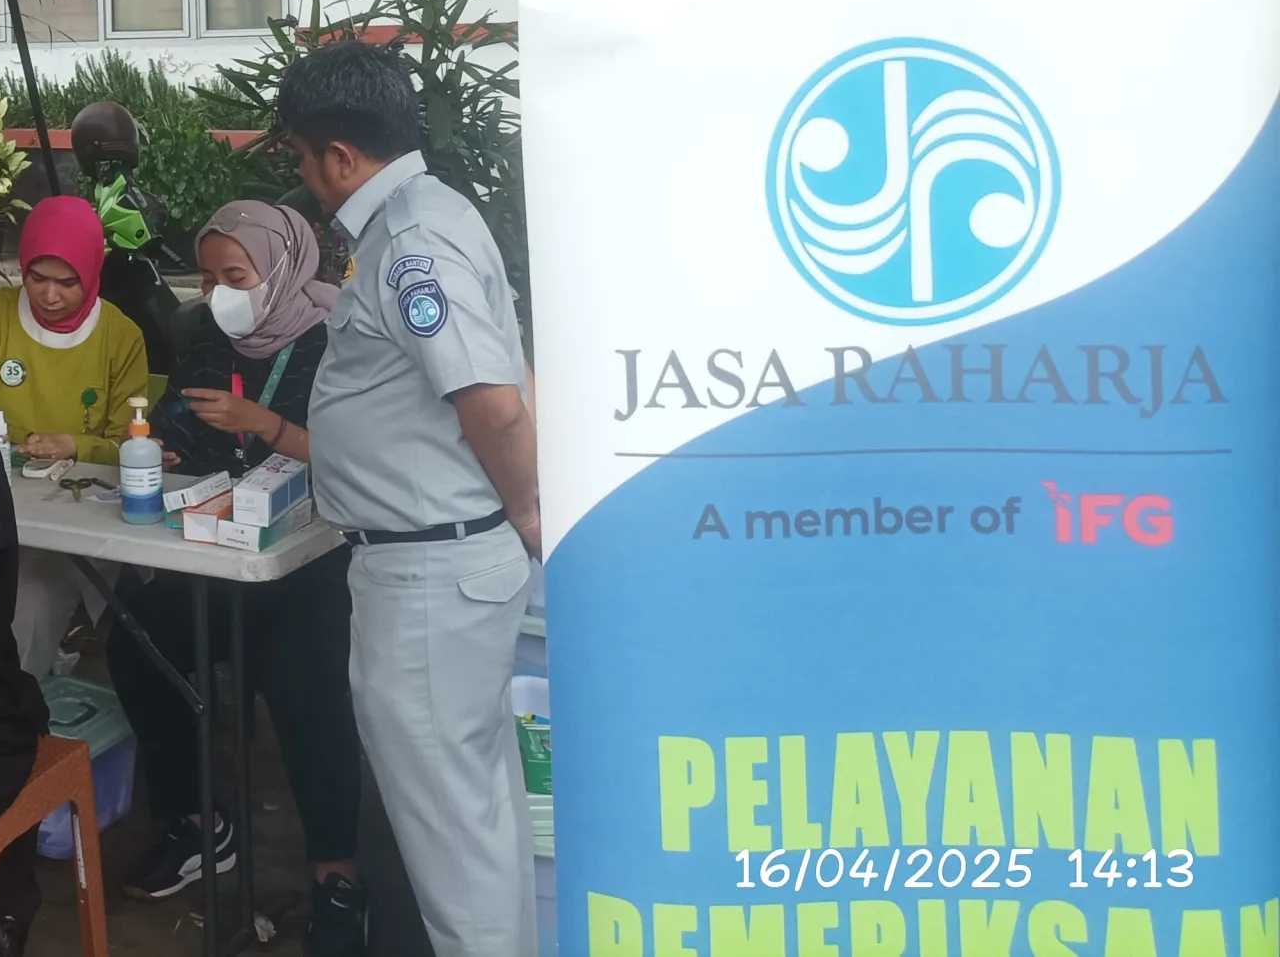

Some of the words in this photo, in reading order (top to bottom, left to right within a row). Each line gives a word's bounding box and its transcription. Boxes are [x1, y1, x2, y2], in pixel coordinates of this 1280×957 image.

[405, 260, 428, 270] BANTEN
[6, 365, 20, 376] 3S
[613, 347, 806, 421] JASA
[824, 343, 1230, 418] RAHARJA
[691, 502, 730, 540] A
[744, 497, 955, 540] member
[969, 496, 1022, 536] of
[658, 731, 1220, 856] PELAYANAN
